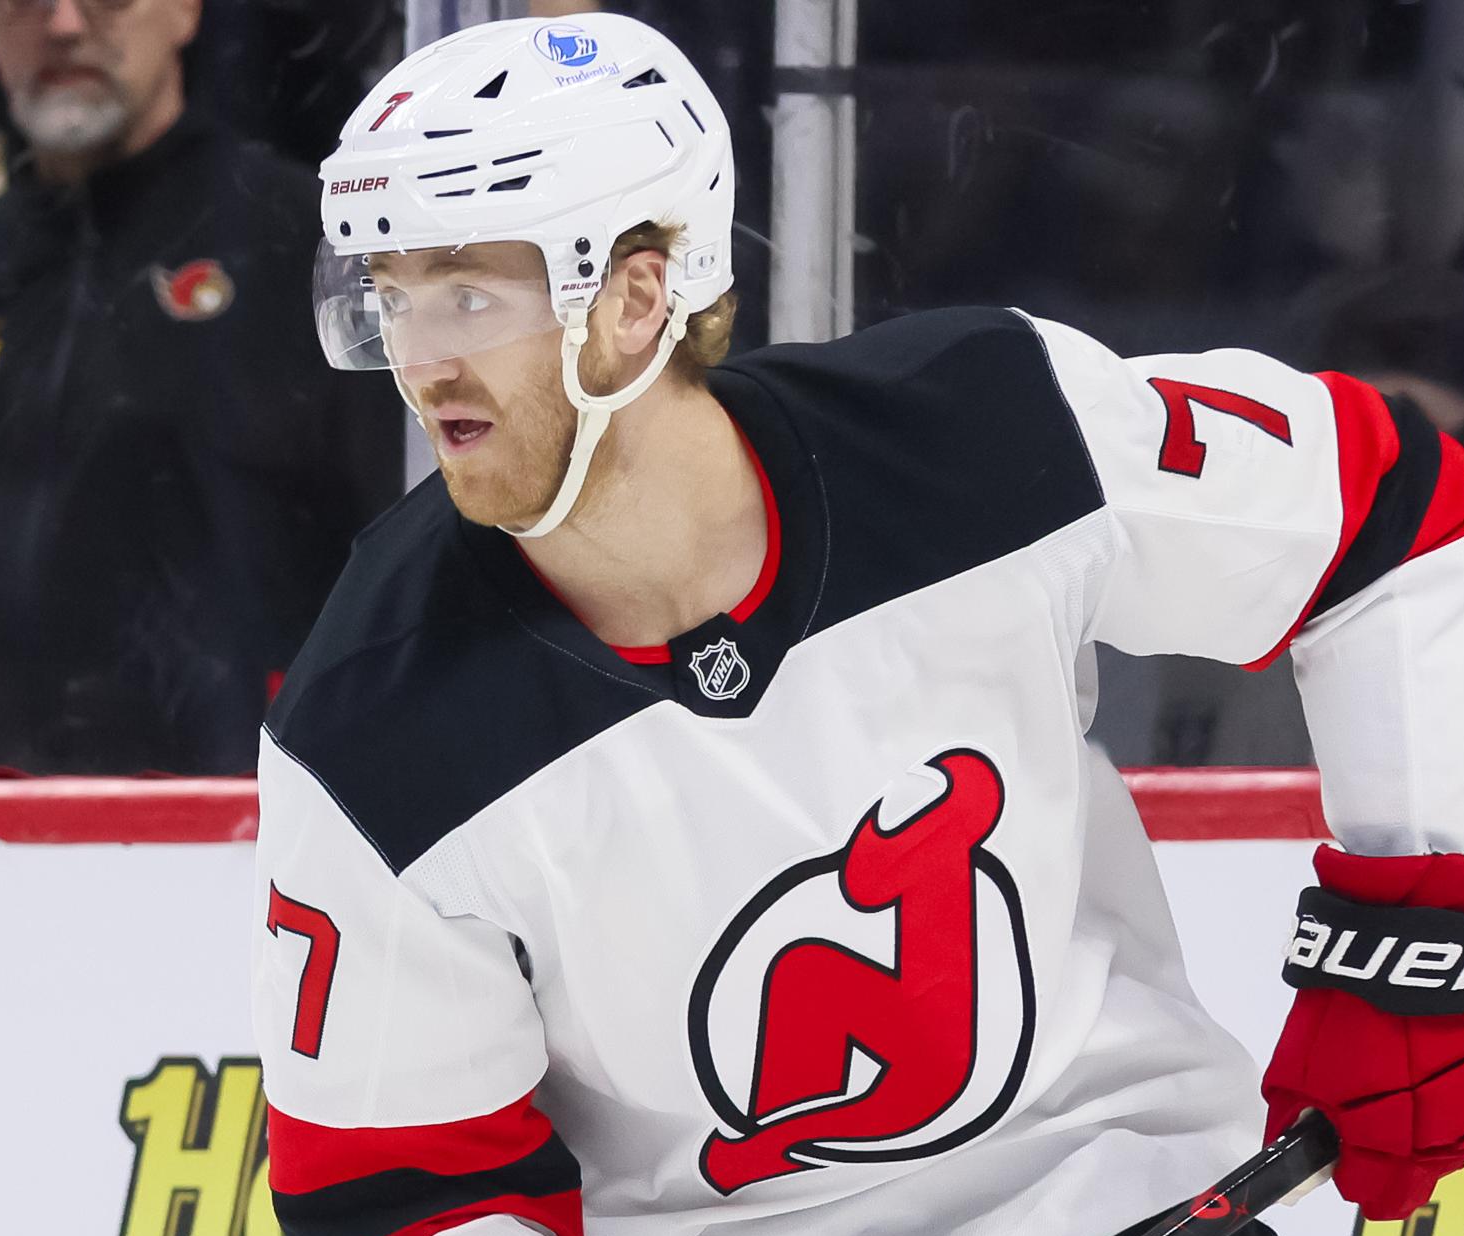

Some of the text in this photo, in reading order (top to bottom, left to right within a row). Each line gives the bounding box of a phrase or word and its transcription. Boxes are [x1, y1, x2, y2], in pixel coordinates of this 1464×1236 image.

[555, 62, 621, 87] Prudential
[368, 91, 414, 132] 7
[330, 176, 390, 195] BAUER
[1146, 377, 1294, 480] 7
[710, 654, 733, 692] NHL
[266, 878, 341, 1059] 7
